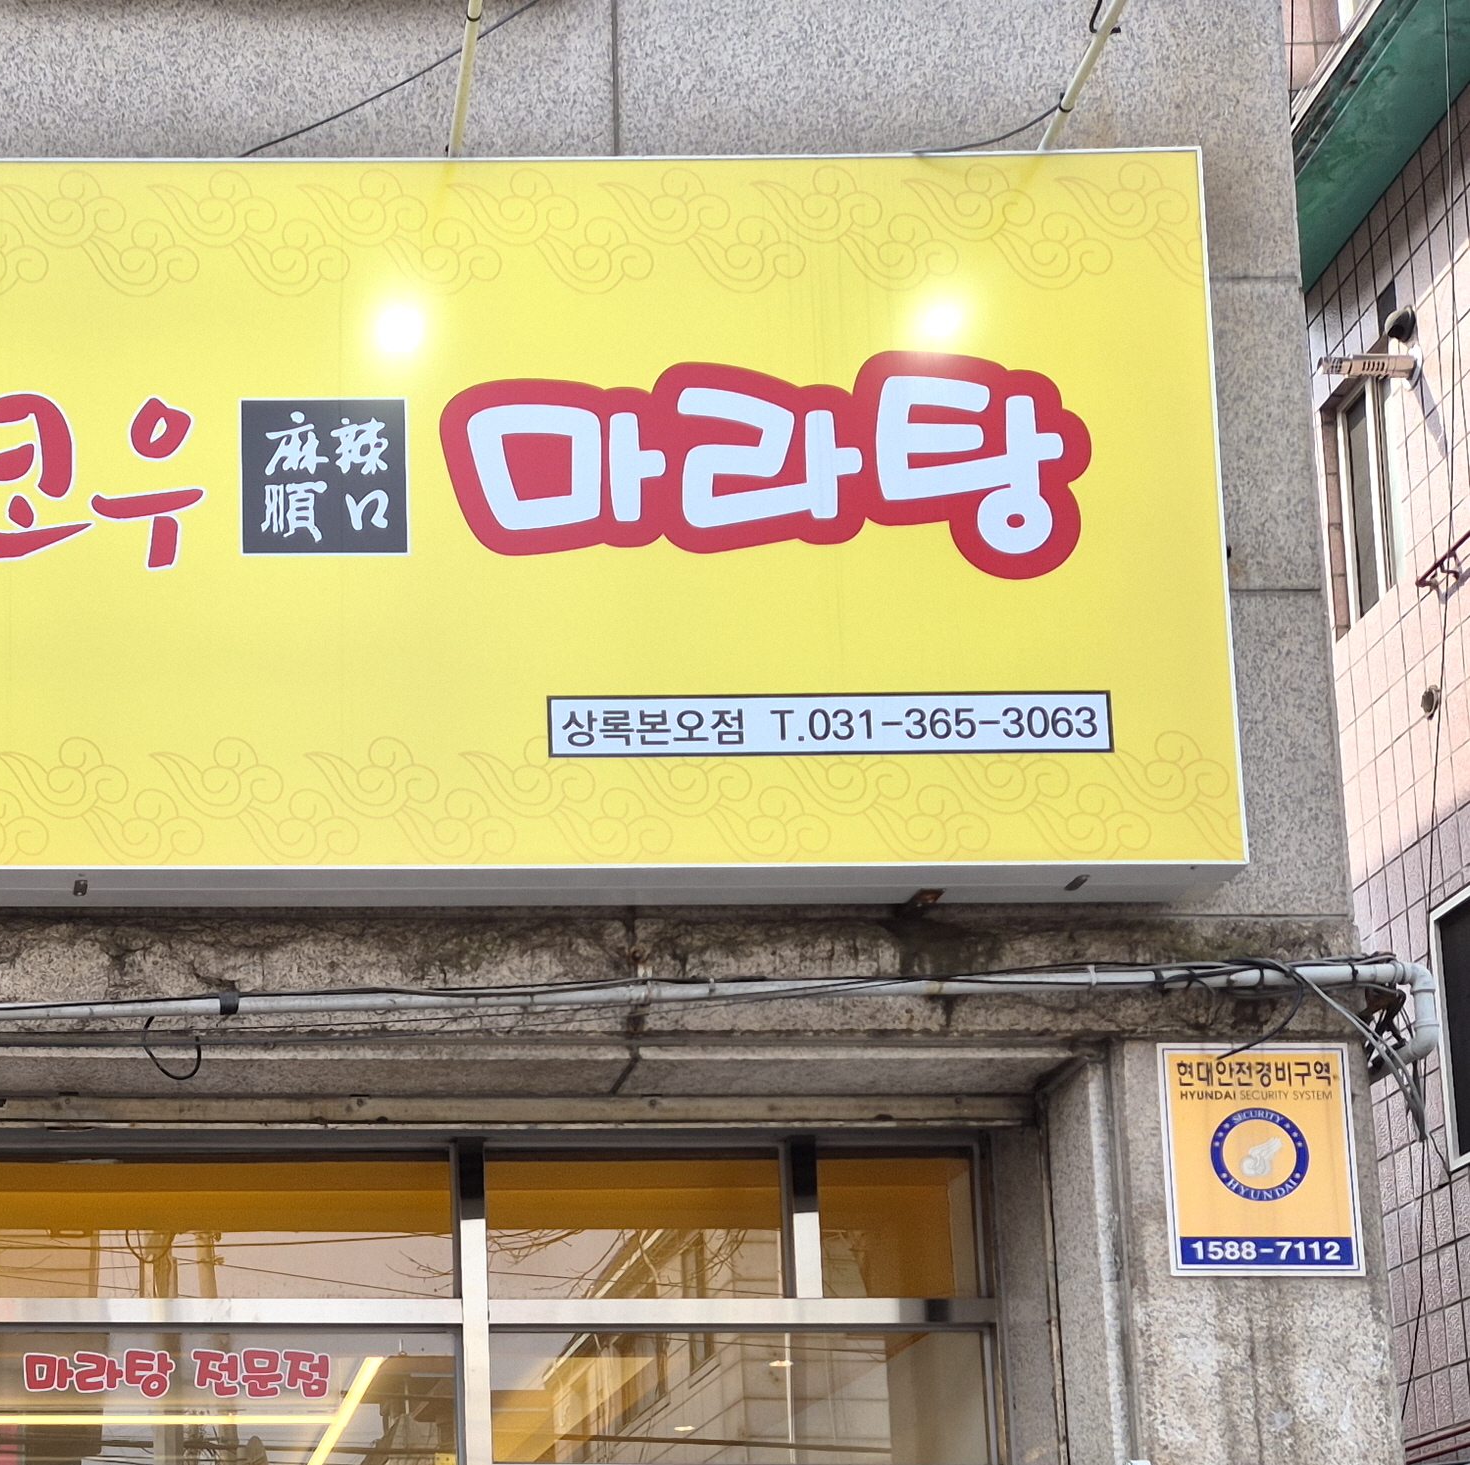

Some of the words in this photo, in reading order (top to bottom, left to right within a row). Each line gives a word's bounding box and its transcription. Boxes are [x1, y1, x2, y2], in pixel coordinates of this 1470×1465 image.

[467, 375, 1063, 554] 마라탕
[561, 708, 746, 747] 상록본오점
[770, 705, 1098, 743] T.031-365-3063
[1176, 1060, 1332, 1088] 현대안전경비구역
[1180, 1091, 1237, 1101] HYUNDAI
[1240, 1090, 1289, 1100] SECURITY
[1293, 1090, 1333, 1100] SYSTEM
[1232, 1109, 1284, 1125] SECURITY
[1226, 1177, 1298, 1200] HYUNDAI
[1190, 1240, 1342, 1261] 1588-7112
[23, 1349, 175, 1398] 마라탕
[192, 1348, 331, 1399] 전문점
